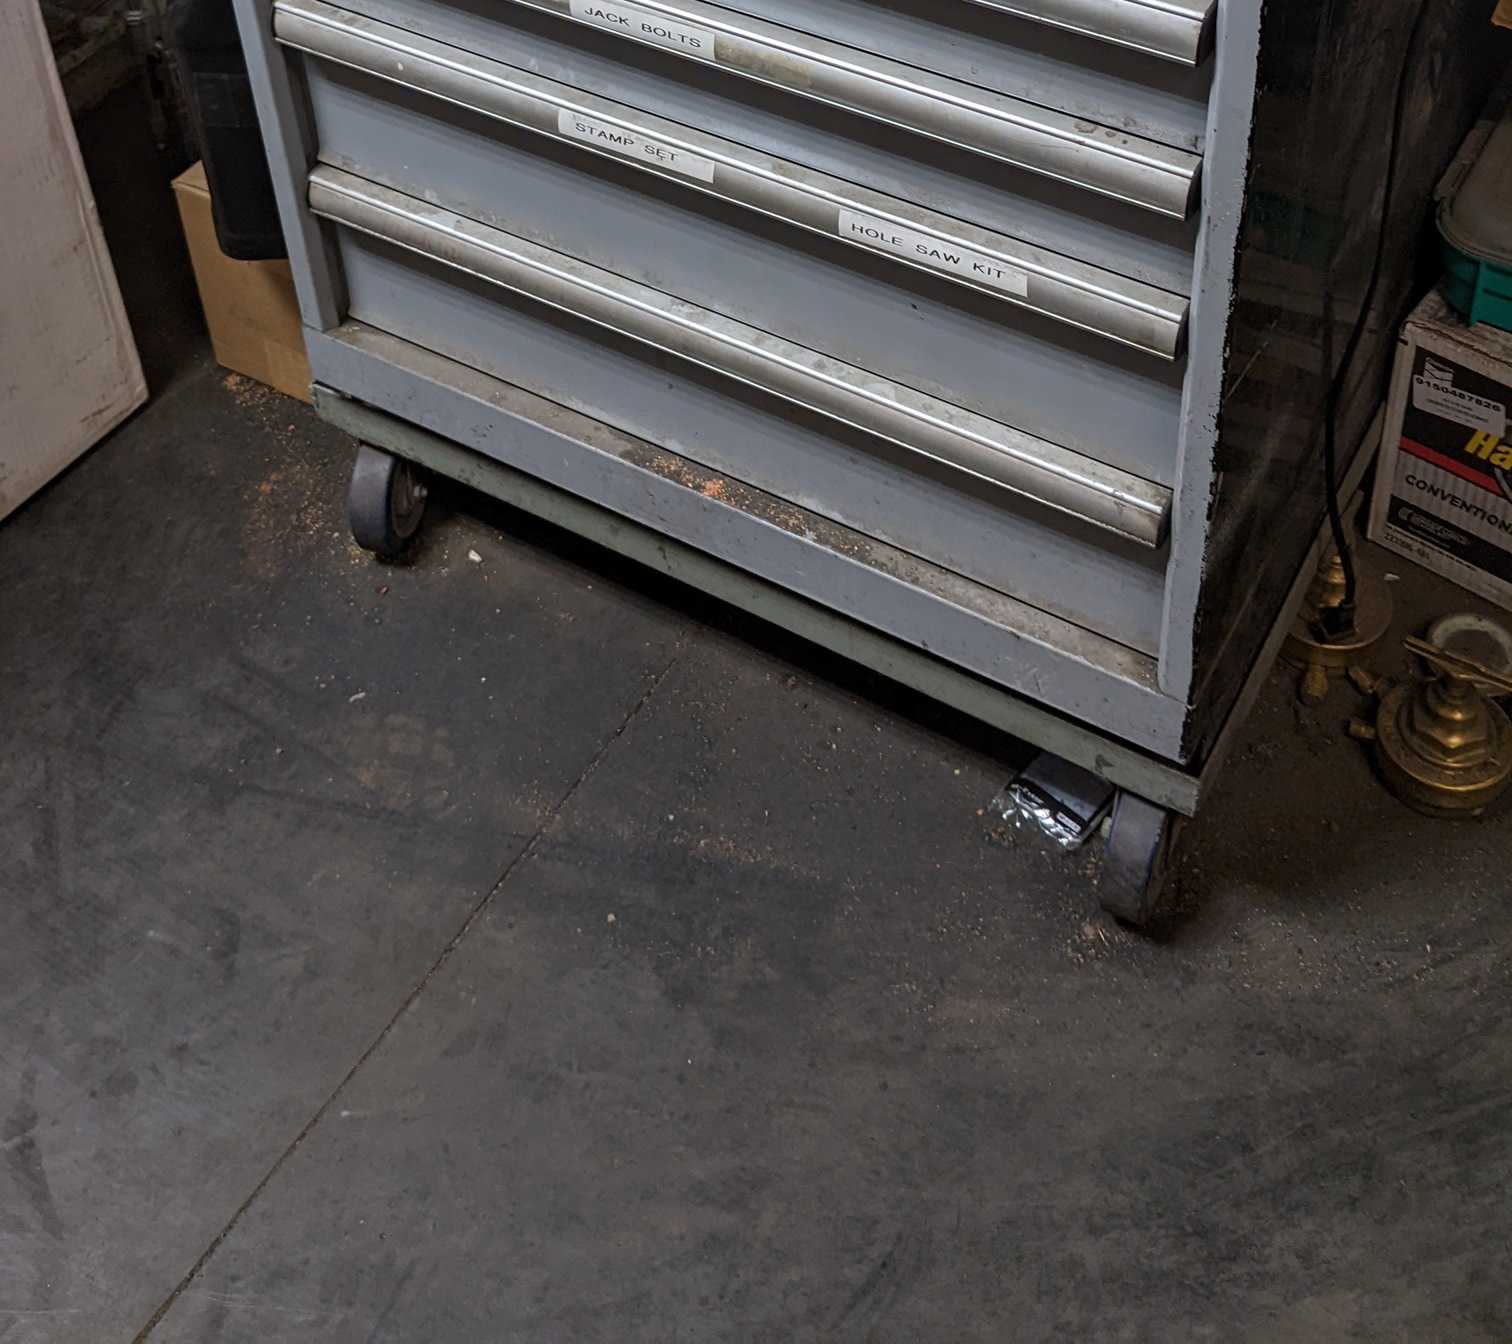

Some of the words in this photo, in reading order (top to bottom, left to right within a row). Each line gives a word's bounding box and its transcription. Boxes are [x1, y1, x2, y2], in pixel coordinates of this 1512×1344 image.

[585, 7, 631, 27] JACK
[641, 23, 702, 48] BOLTS
[575, 122, 635, 146] STAMP
[644, 144, 679, 161] SET
[851, 223, 904, 247] HOLE
[916, 244, 961, 264] SAW
[973, 261, 1006, 279] KIT
[1405, 473, 1512, 535] CONVENTION
